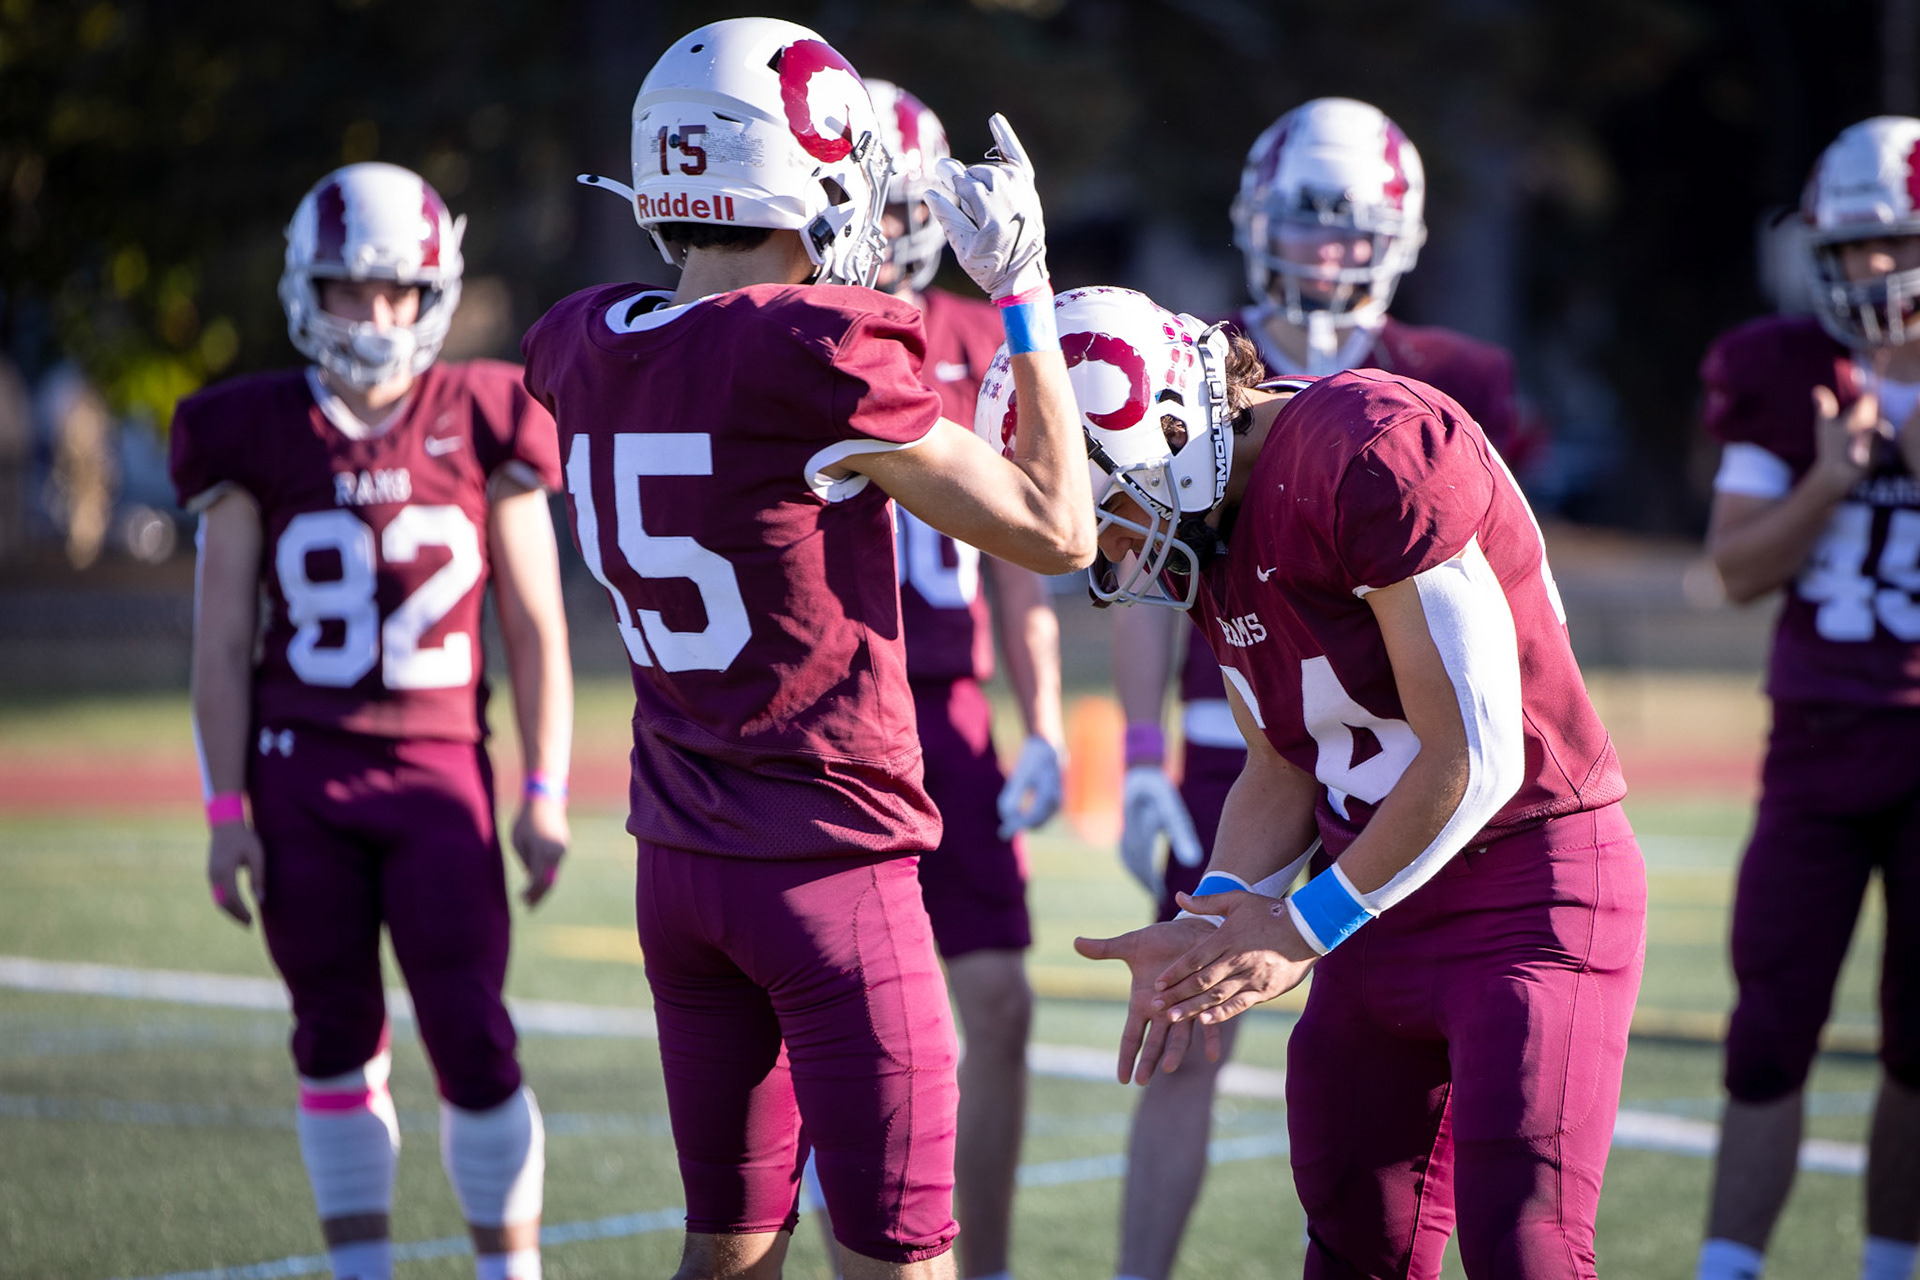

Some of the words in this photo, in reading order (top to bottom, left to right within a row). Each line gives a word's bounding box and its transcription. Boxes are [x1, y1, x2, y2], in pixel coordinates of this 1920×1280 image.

[657, 124, 708, 176] 15
[636, 191, 735, 222] Riddell
[333, 467, 412, 505] RAMS
[565, 432, 753, 673] 15
[275, 505, 482, 690] 82
[1215, 612, 1268, 647] RAMS
